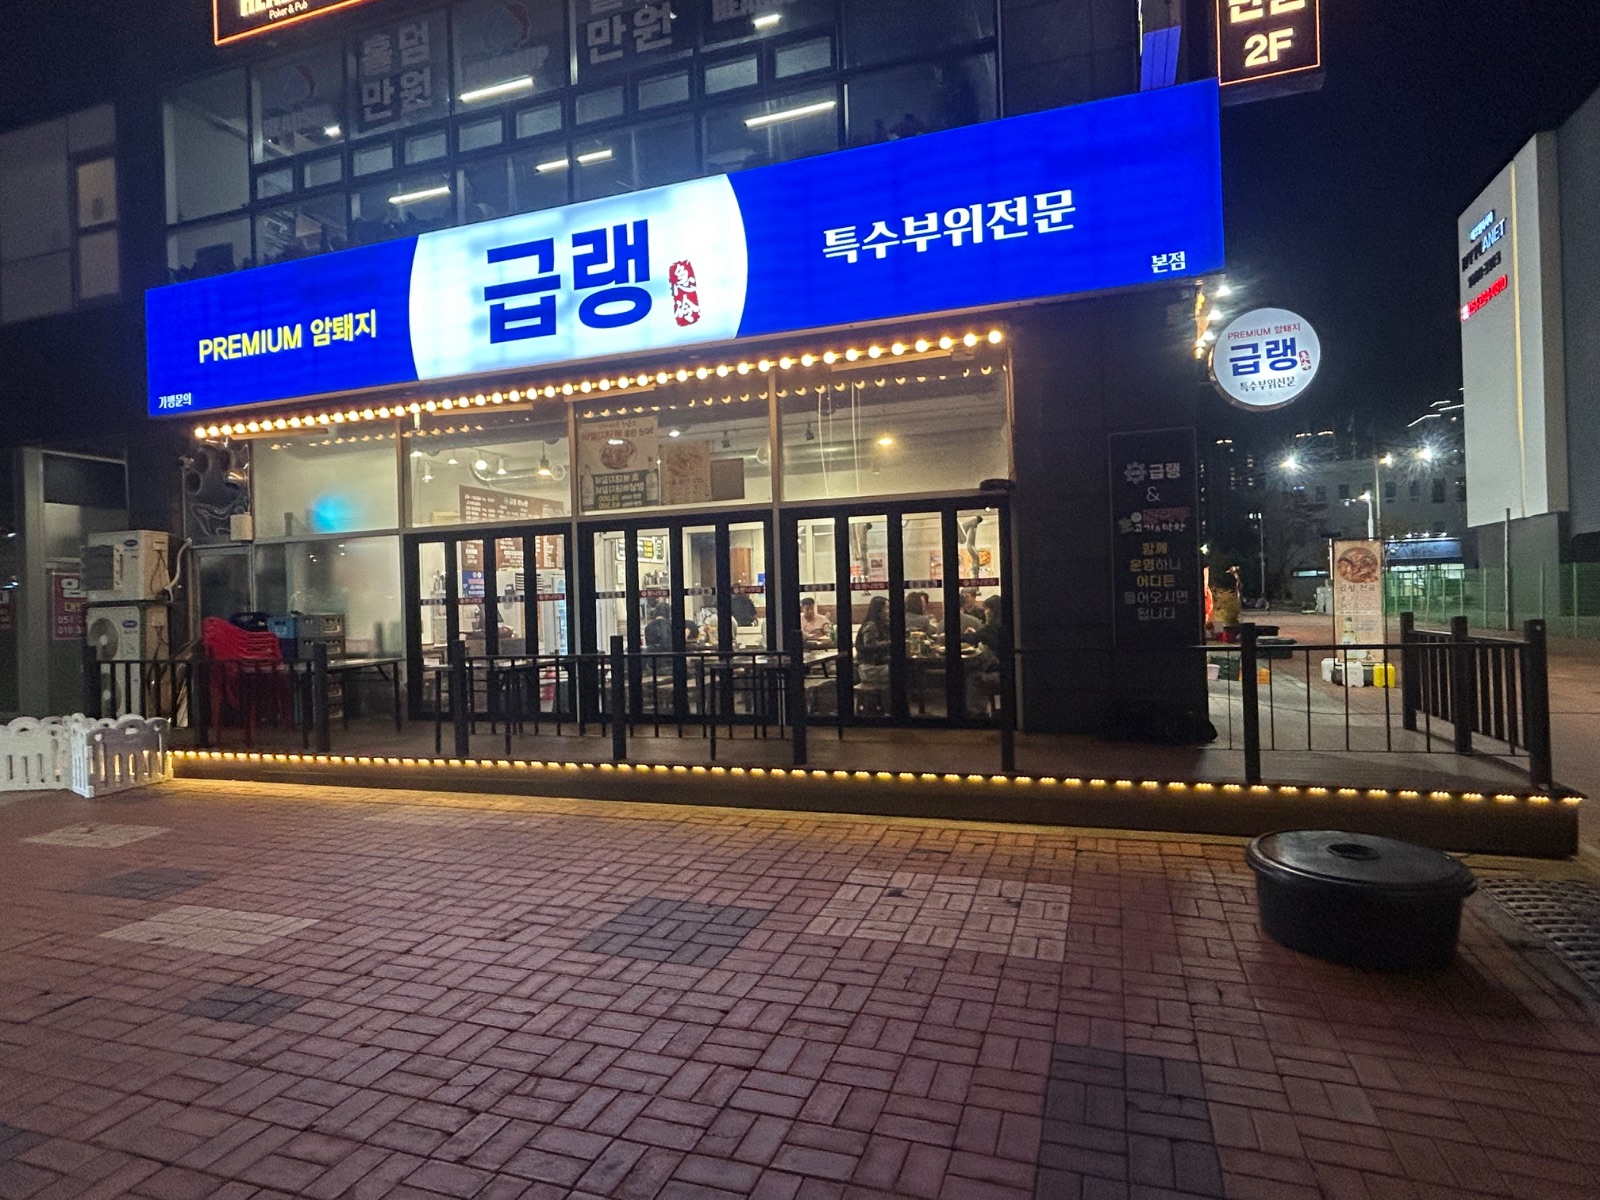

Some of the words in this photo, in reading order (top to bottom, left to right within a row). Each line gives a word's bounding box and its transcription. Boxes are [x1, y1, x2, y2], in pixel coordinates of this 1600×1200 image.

[269, 7, 288, 20] Poker
[288, 4, 295, 14] &
[295, 1, 308, 12] Pub
[1244, 27, 1294, 67] 2F
[823, 189, 1076, 264] 특수부위전문
[1151, 251, 1186, 274] 본점
[484, 219, 652, 344] 급랭
[670, 260, 700, 327] 急冷
[199, 324, 302, 364] PREMIUM
[310, 308, 376, 347] 암퇘지
[1228, 327, 1271, 340] PREMIUM
[1229, 337, 1298, 376] 급랭
[1240, 376, 1296, 392] 특수부위전문
[158, 392, 192, 409] 가맹문의
[1150, 462, 1181, 480] 급랭
[1147, 486, 1160, 502] &
[1142, 542, 1168, 554] 함께
[1130, 558, 1181, 572] 운영하니
[1137, 574, 1175, 587] 어디든
[1124, 590, 1189, 604] 들어오시면
[1138, 607, 1176, 620] 됩니다
